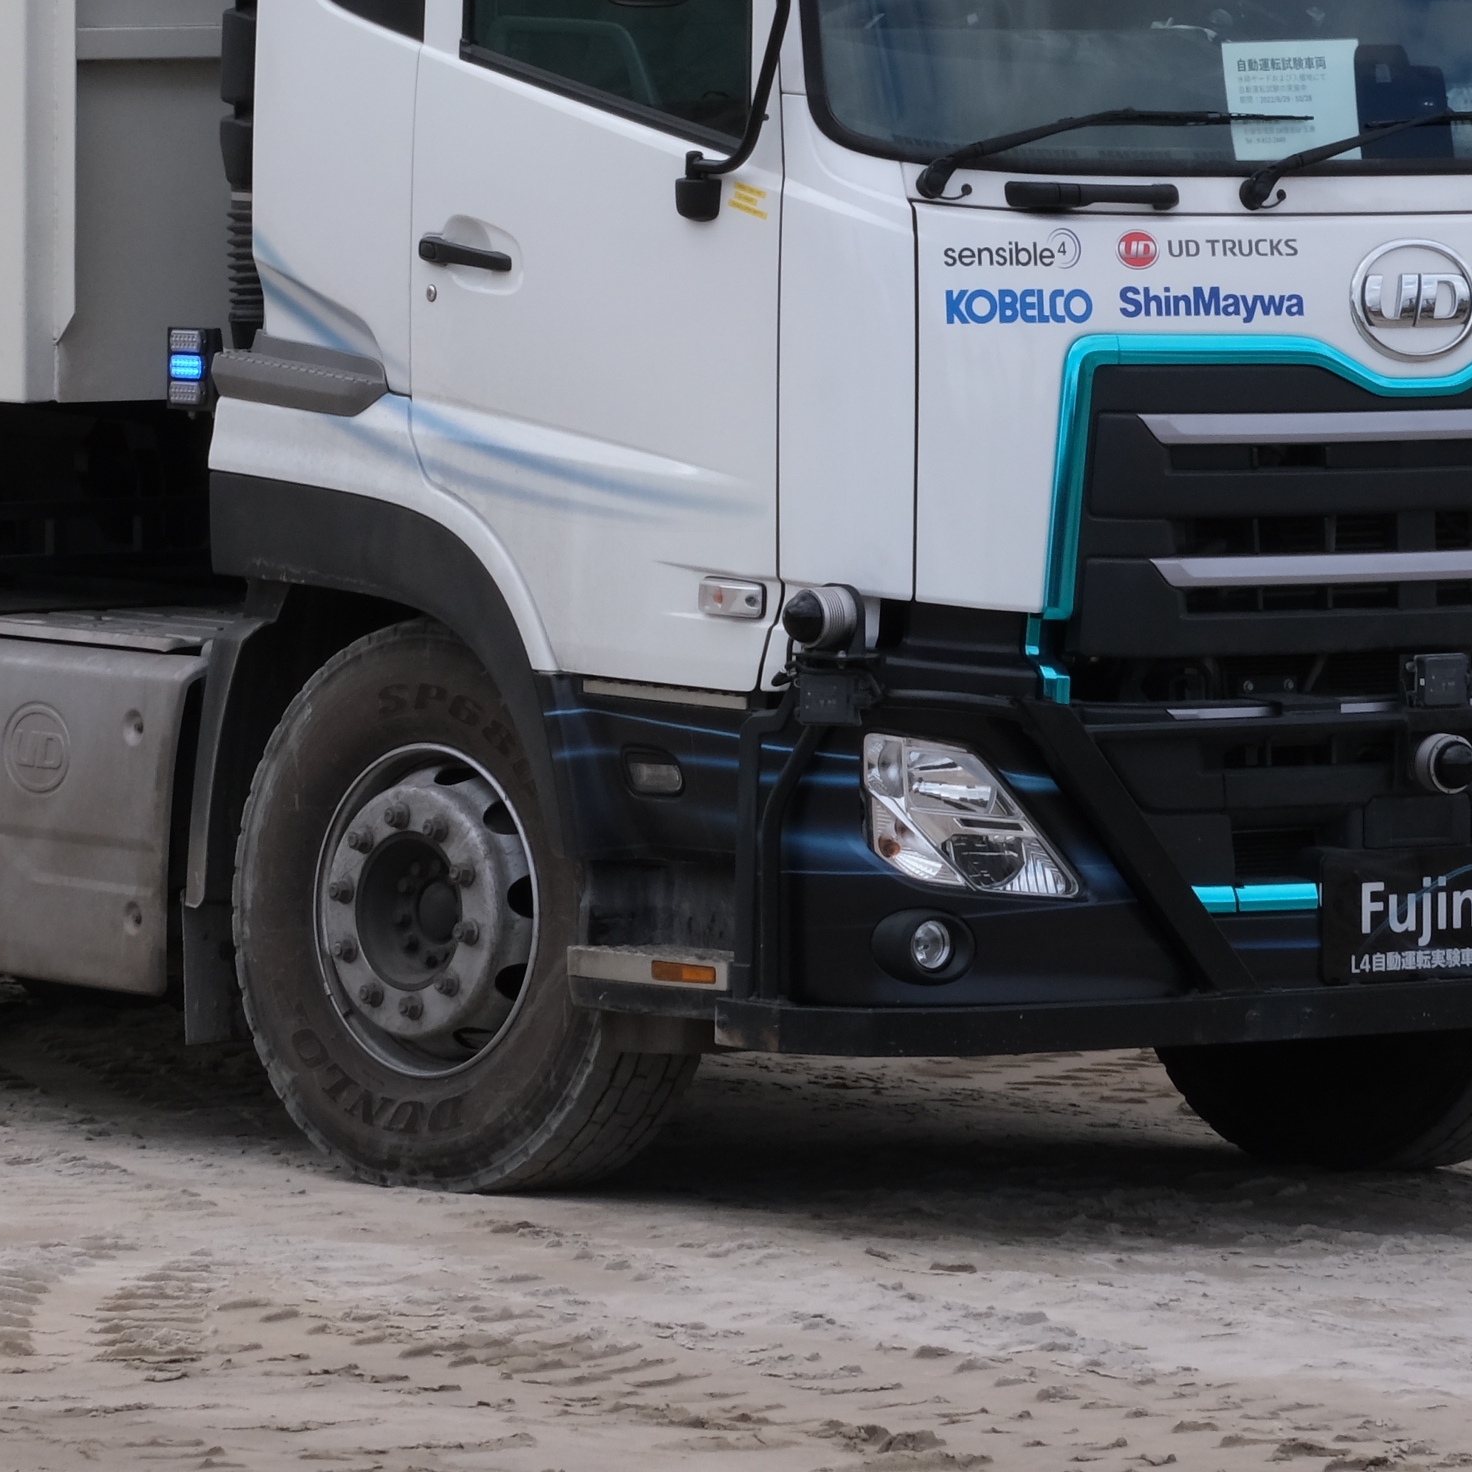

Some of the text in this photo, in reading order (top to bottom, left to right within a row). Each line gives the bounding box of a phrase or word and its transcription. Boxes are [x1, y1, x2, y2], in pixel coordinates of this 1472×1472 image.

[1236, 56, 1326, 72] 自動運転試験車両
[1168, 239, 1200, 257] UD
[1206, 238, 1298, 258] TRUCKS
[945, 289, 1093, 324] KOBELCO
[1119, 286, 1304, 323] ShinMaywa
[1363, 273, 1472, 327] UD
[15, 728, 65, 770] UD
